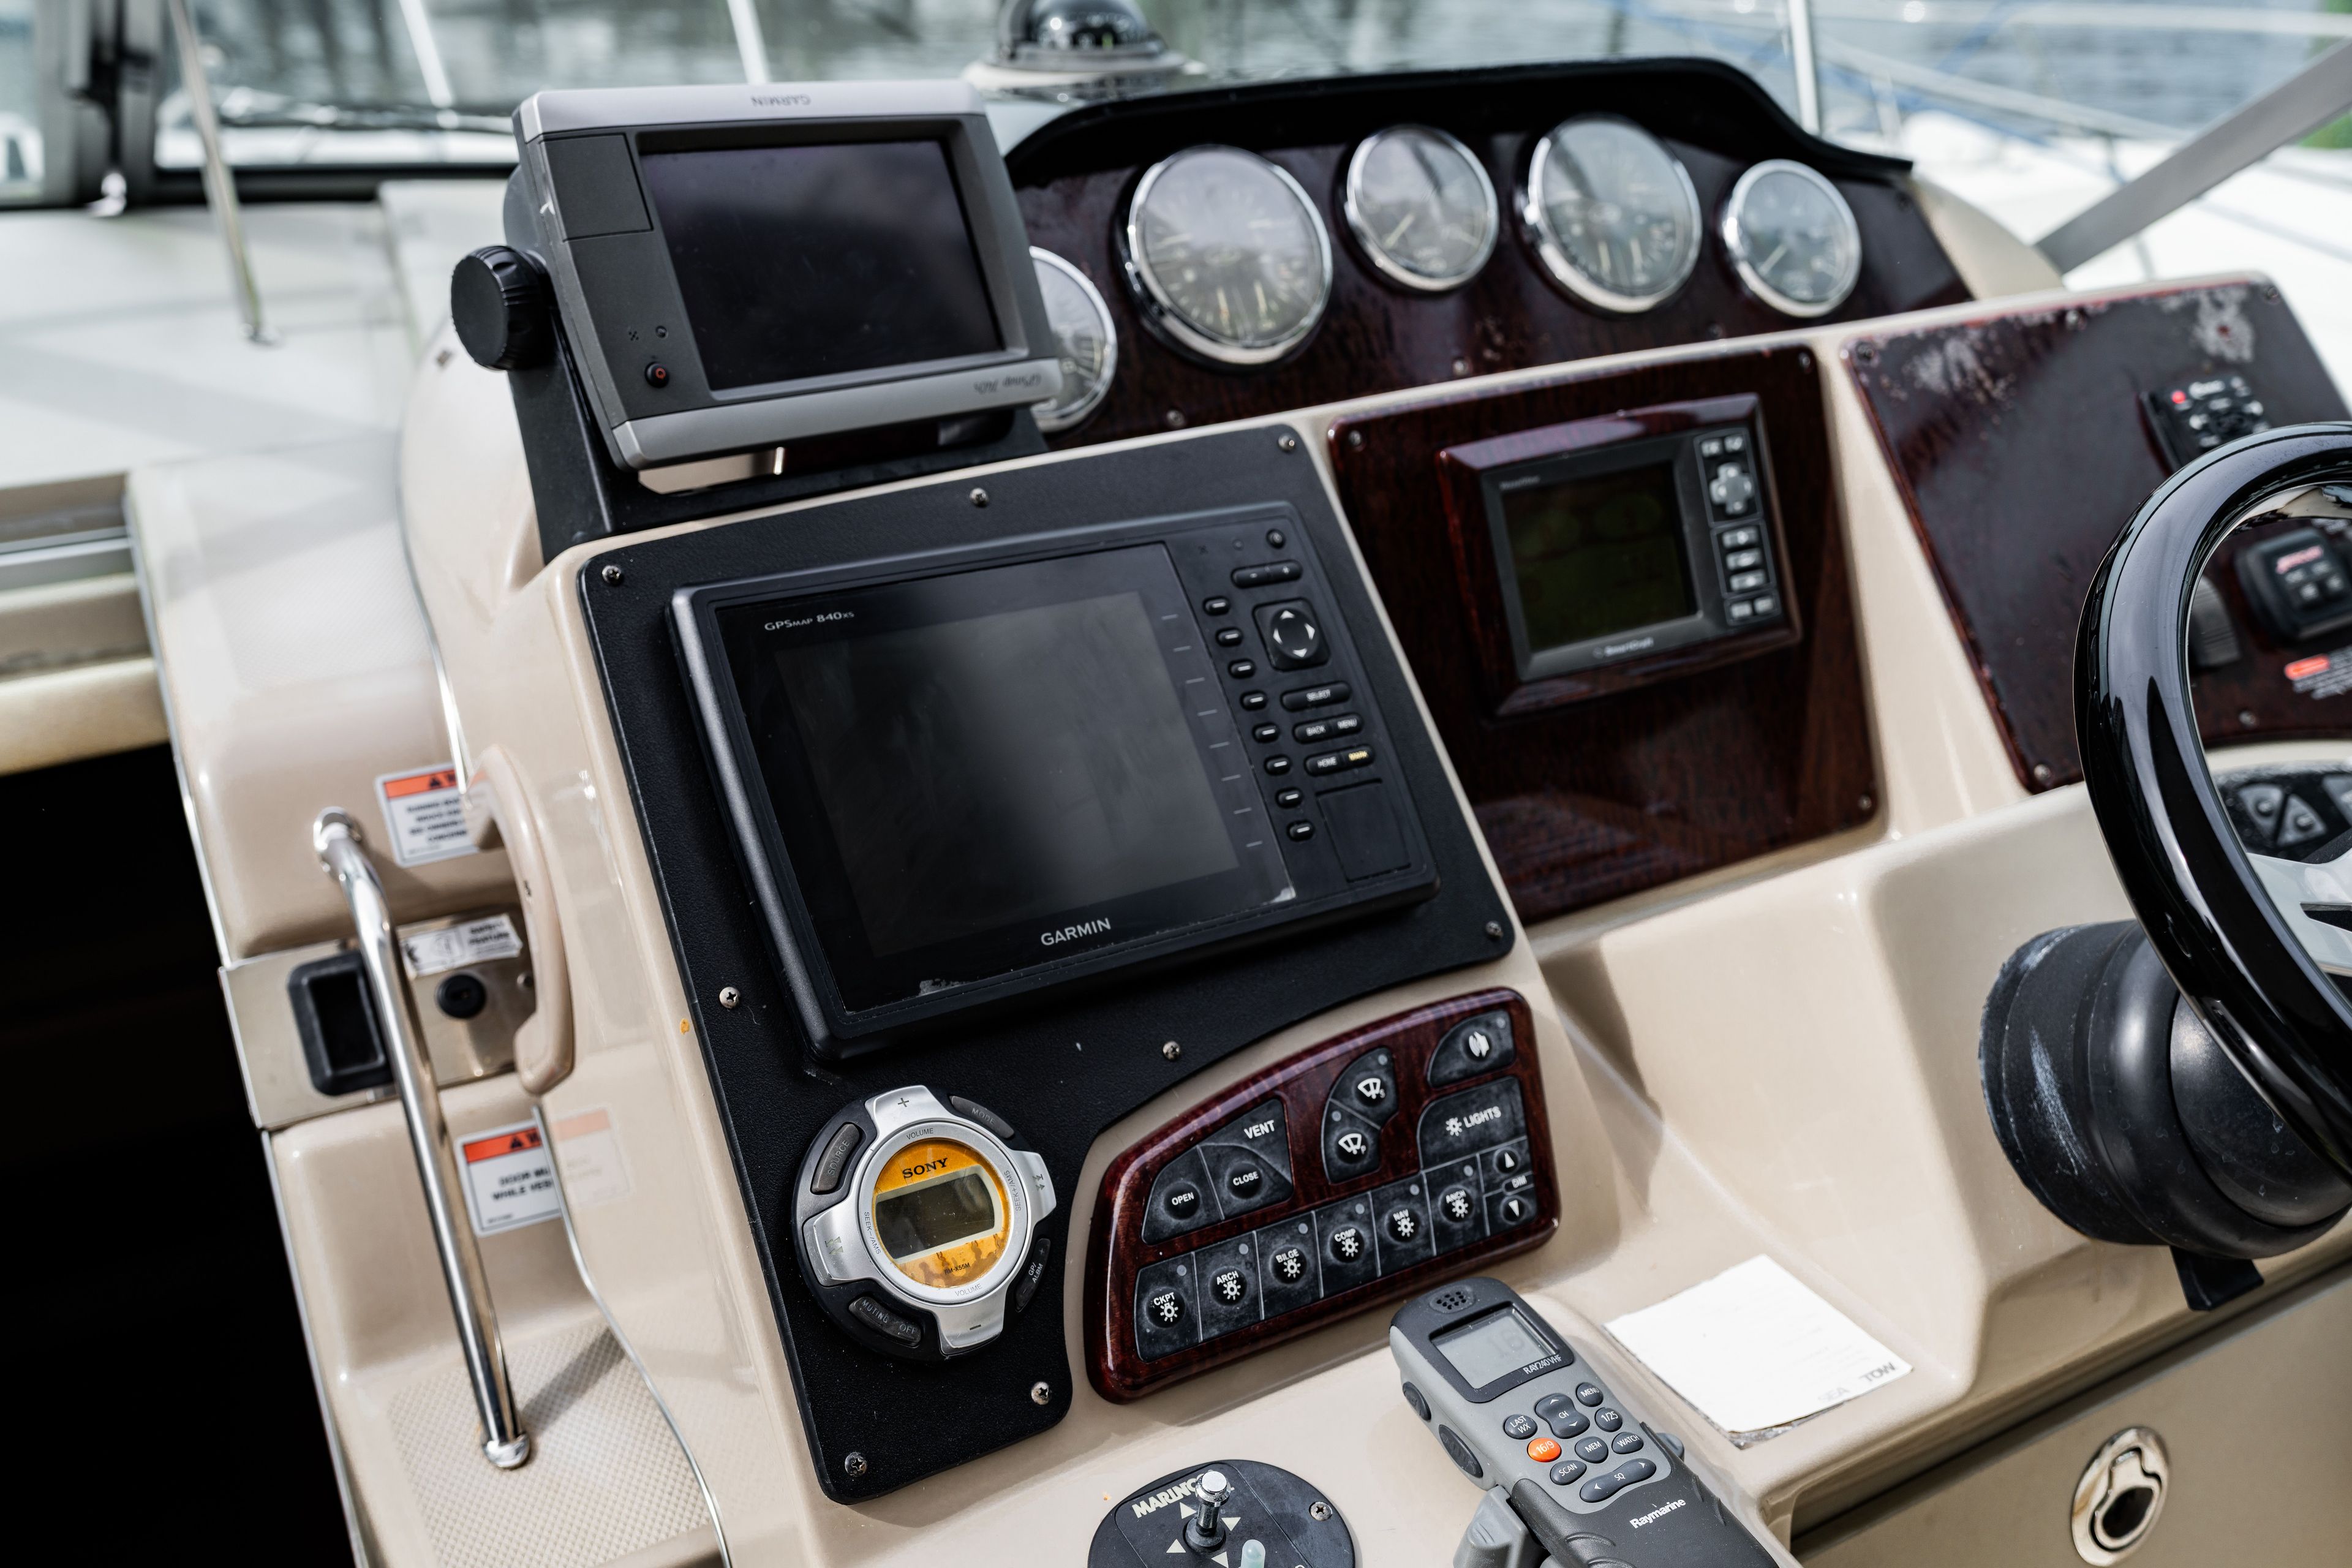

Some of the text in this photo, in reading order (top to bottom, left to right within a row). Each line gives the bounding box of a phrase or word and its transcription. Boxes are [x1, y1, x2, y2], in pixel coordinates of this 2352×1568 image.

[750, 94, 811, 107] GARMIN
[1306, 689, 1331, 702] SELECT
[1337, 718, 1357, 729] MENU
[1041, 918, 1112, 946] GARMIN
[971, 1107, 996, 1126] MODE
[1463, 1106, 1502, 1128] LIGHTS
[906, 1128, 934, 1140] VOLUME
[1244, 1120, 1275, 1139] VENT
[827, 1140, 850, 1175] SOURCE
[902, 1158, 948, 1179] SONY
[1233, 1171, 1259, 1186] CLOSE
[1172, 1192, 1194, 1206] OPEN
[1393, 1209, 1409, 1221] NAV
[1334, 1228, 1356, 1242] COMP
[1276, 1248, 1300, 1263] BILGE
[1032, 1263, 1043, 1284] ALBM
[1216, 1270, 1238, 1285] ARCH
[954, 1283, 982, 1297] VOLUME
[1153, 1292, 1175, 1306] CKPT
[861, 1299, 889, 1324] MUTING
[899, 1324, 917, 1335] OFF
[1549, 1354, 1562, 1365] VHF
[1858, 1362, 1897, 1382] TOW
[1580, 1386, 1600, 1398] MENU
[1510, 1415, 1527, 1428] LAST
[1558, 1411, 1569, 1419] CH
[1601, 1411, 1619, 1423] 1/25
[1518, 1422, 1532, 1434] WX
[1536, 1440, 1555, 1455] 16/9
[1585, 1441, 1602, 1453] MEM
[1617, 1434, 1640, 1448] WATCH
[1558, 1463, 1578, 1477] SCAN
[1614, 1472, 1626, 1481] SQ
[1132, 1470, 1214, 1518] MARINC
[1629, 1499, 1686, 1529] Raymarine
